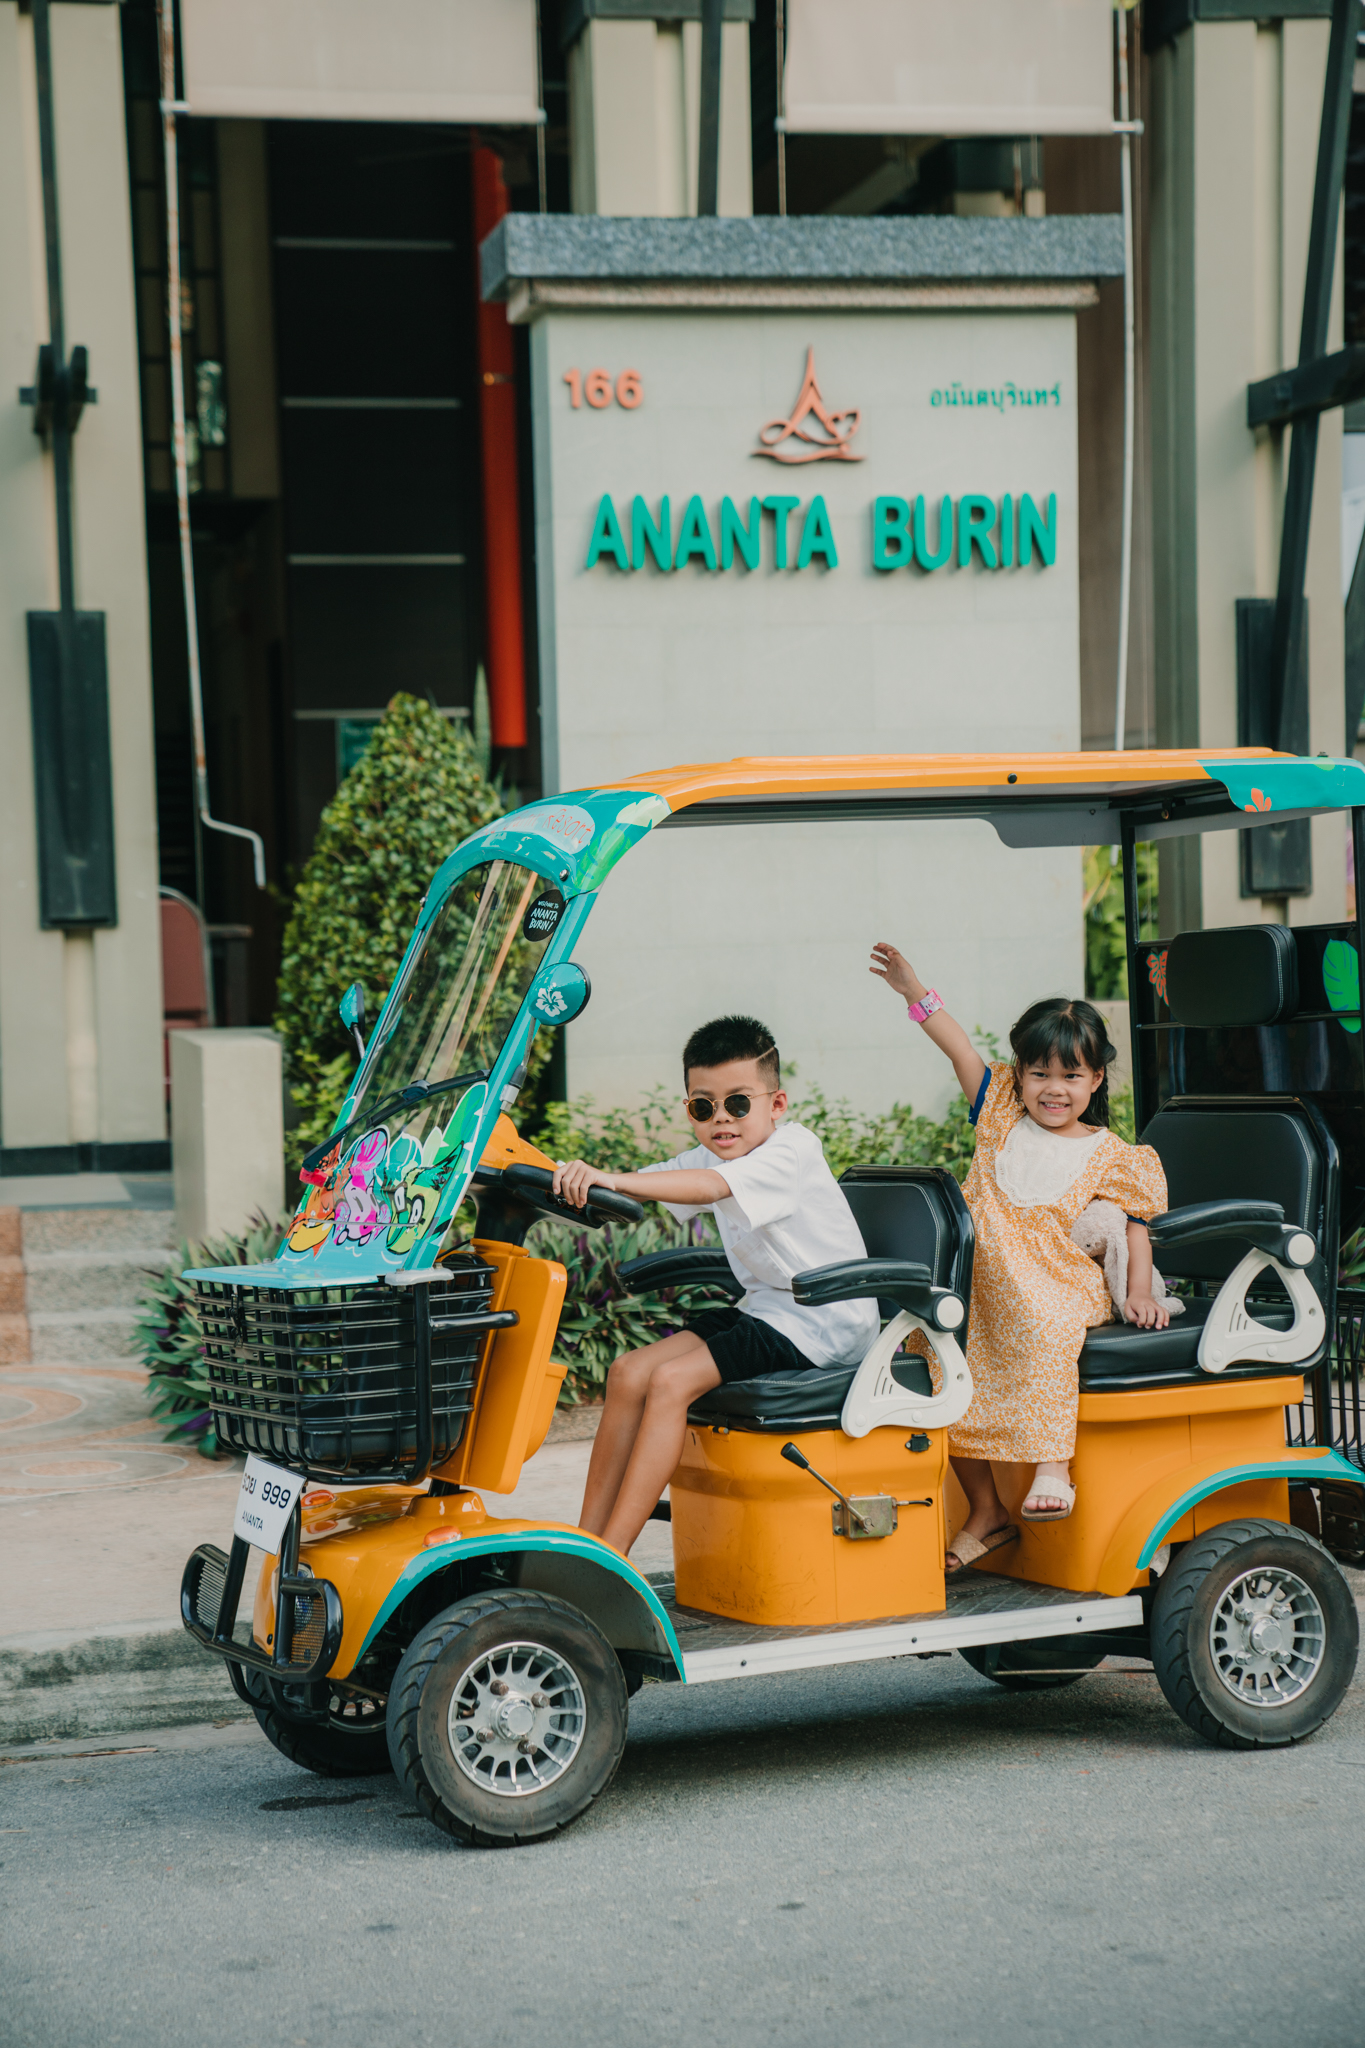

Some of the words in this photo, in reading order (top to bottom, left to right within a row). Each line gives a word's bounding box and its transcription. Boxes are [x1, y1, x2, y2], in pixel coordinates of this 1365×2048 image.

[562, 367, 645, 410] 166
[586, 493, 839, 571] ANANTA
[872, 492, 1058, 571] BURIN
[530, 907, 558, 921] ANANTA
[261, 1481, 291, 1509] 999
[241, 1510, 264, 1531] ANANTA
